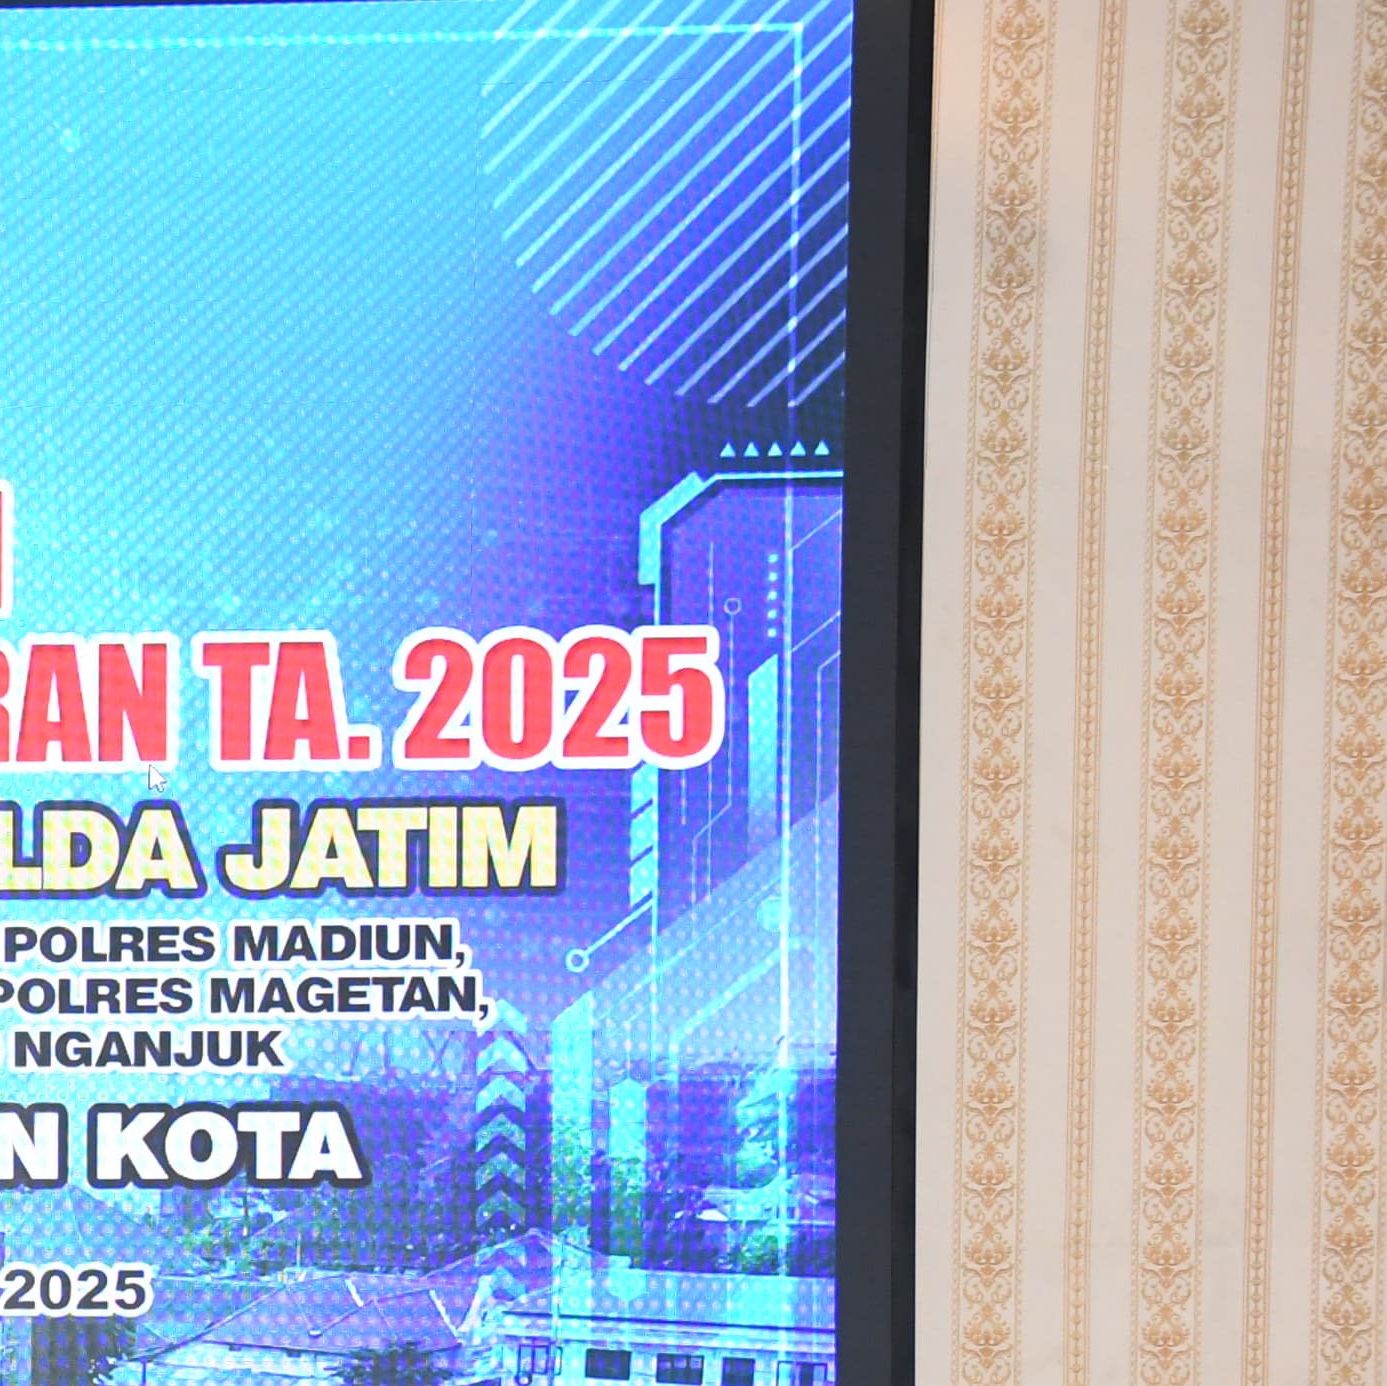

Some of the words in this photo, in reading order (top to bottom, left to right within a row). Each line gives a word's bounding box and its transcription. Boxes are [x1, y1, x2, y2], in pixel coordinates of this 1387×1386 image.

[202, 641, 372, 761] TA.
[403, 636, 714, 761] 2025
[224, 804, 558, 890] JATIM
[4, 926, 215, 964] POLRES
[233, 924, 466, 969] MADIUN,
[211, 976, 489, 1019] MAGETAN,
[14, 1030, 284, 1068] NGANJUK
[96, 1110, 362, 1181] KOTA
[4, 1269, 146, 1311] 2025
